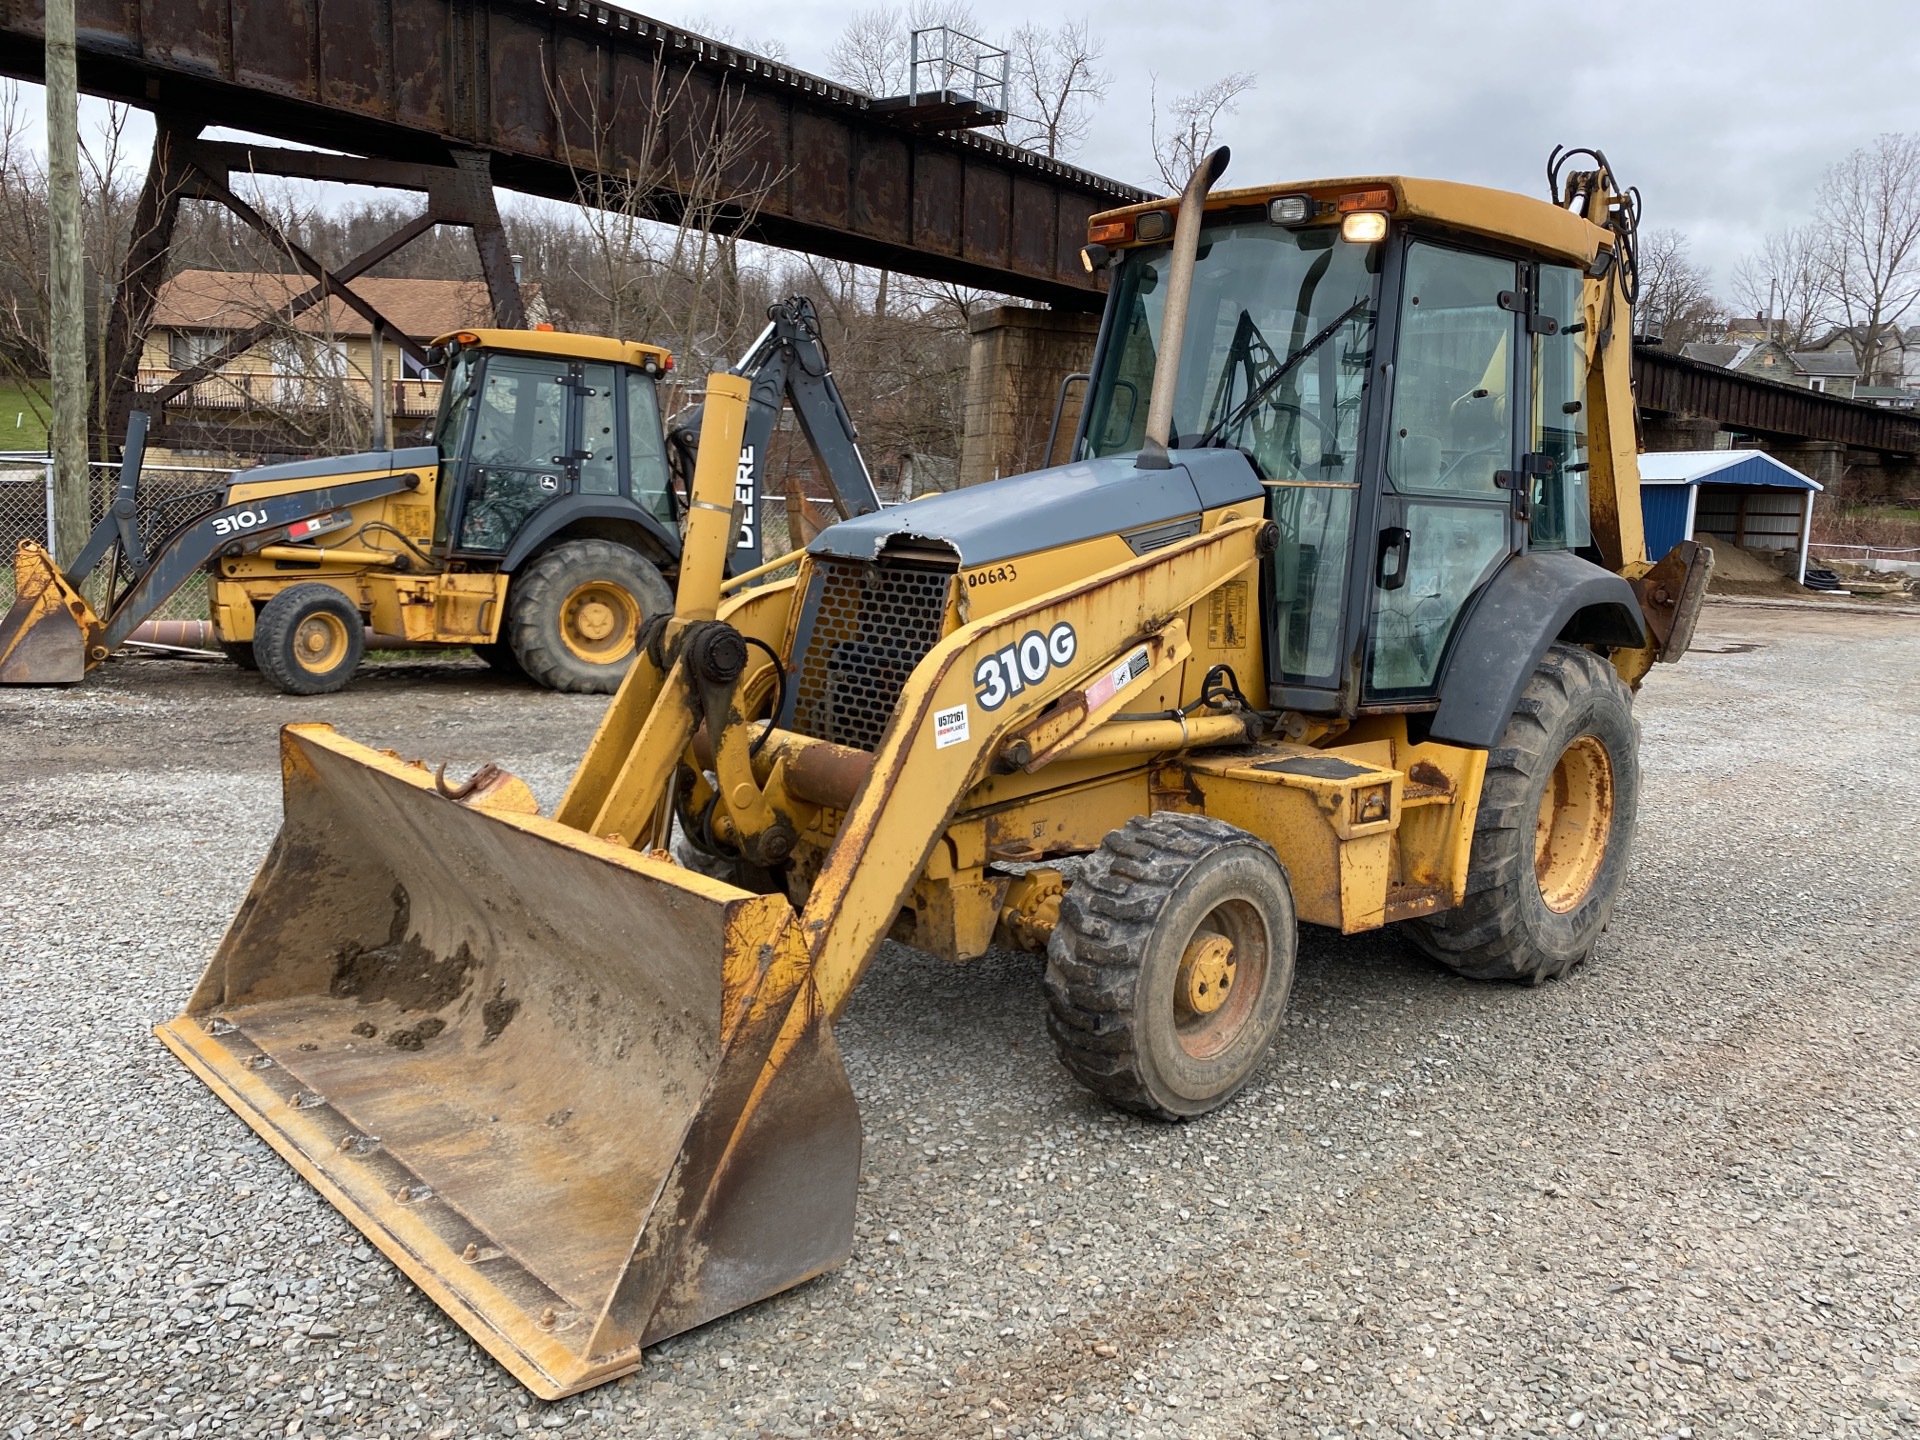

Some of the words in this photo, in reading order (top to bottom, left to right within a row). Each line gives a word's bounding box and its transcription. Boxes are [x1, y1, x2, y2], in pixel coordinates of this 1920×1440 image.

[211, 509, 268, 535] 310J
[968, 564, 1017, 587] 00623
[974, 622, 1076, 710] 310G
[938, 710, 964, 727] U572161
